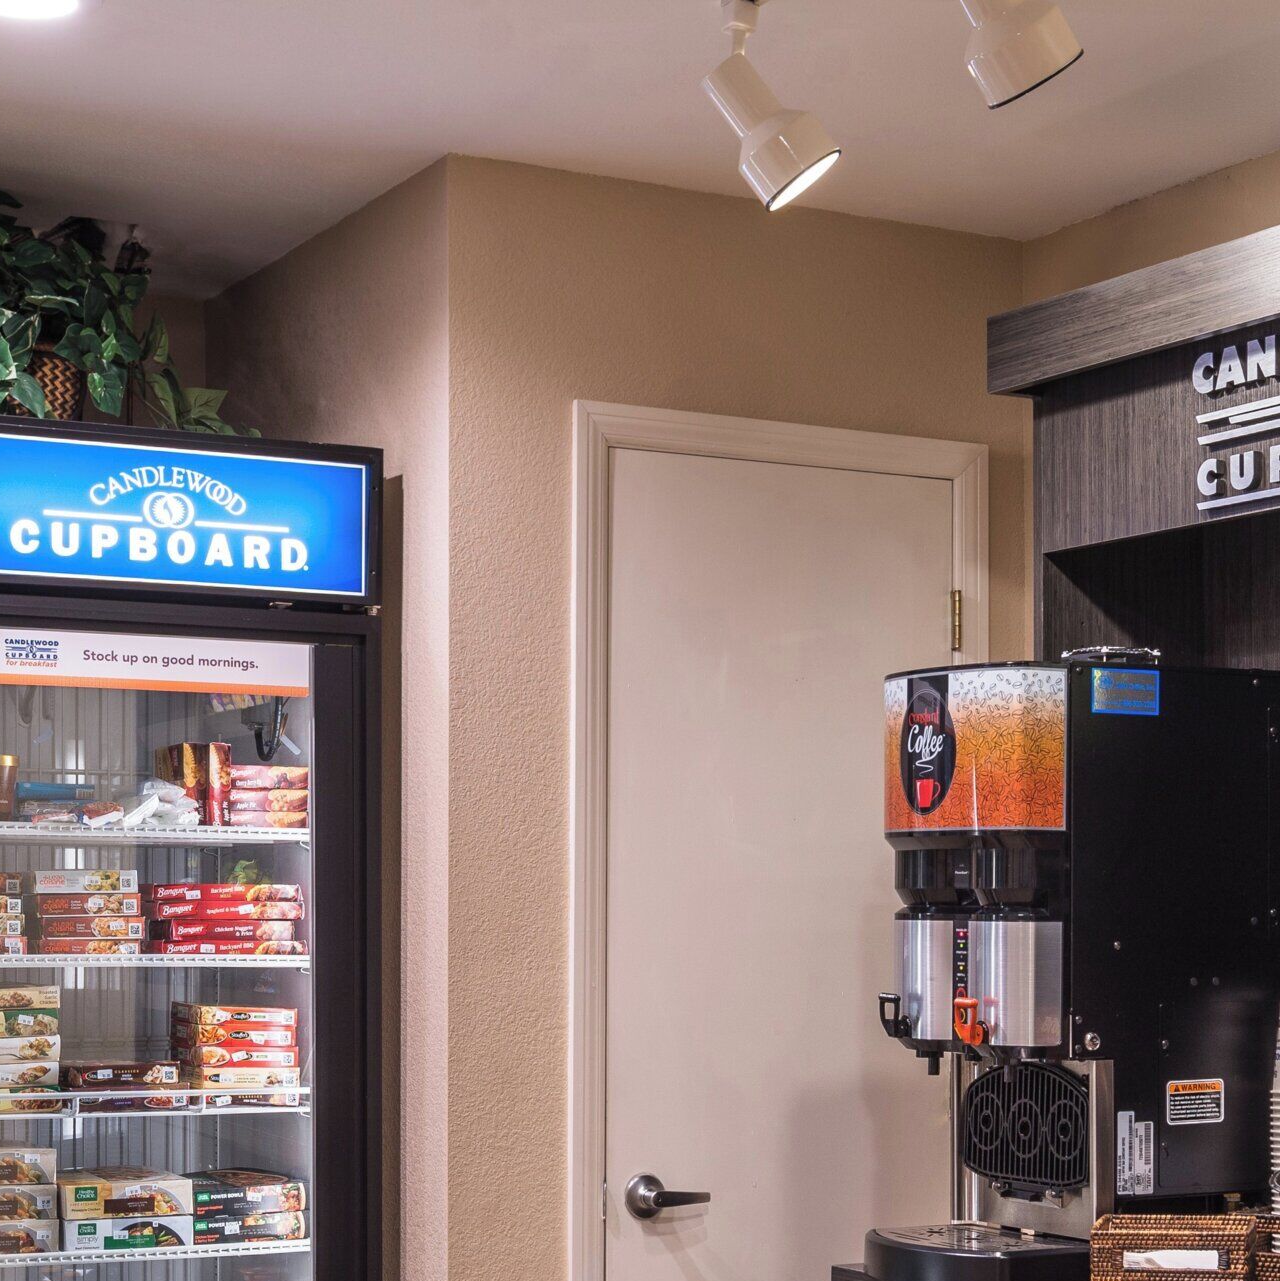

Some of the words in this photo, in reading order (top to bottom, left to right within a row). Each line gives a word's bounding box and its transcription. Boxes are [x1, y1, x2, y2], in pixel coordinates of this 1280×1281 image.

[89, 466, 247, 517] CANDLEWOOD
[10, 520, 306, 571] CUPBOARD
[4, 637, 60, 647] CANDLEWOOD
[83, 649, 120, 666] Stock
[123, 654, 140, 669] up
[143, 655, 159, 666] on
[162, 652, 195, 671] good
[198, 655, 259, 672] mornings.
[908, 724, 943, 758] Coffee
[157, 887, 189, 898] Banquet
[163, 904, 193, 915] Banquet
[177, 925, 204, 935] Banquet
[167, 943, 198, 954] Banquet
[1181, 1082, 1216, 1092] WARNING
[211, 1192, 226, 1200] POWER
[226, 1191, 243, 1199] BOWLS
[77, 1235, 99, 1245] simply
